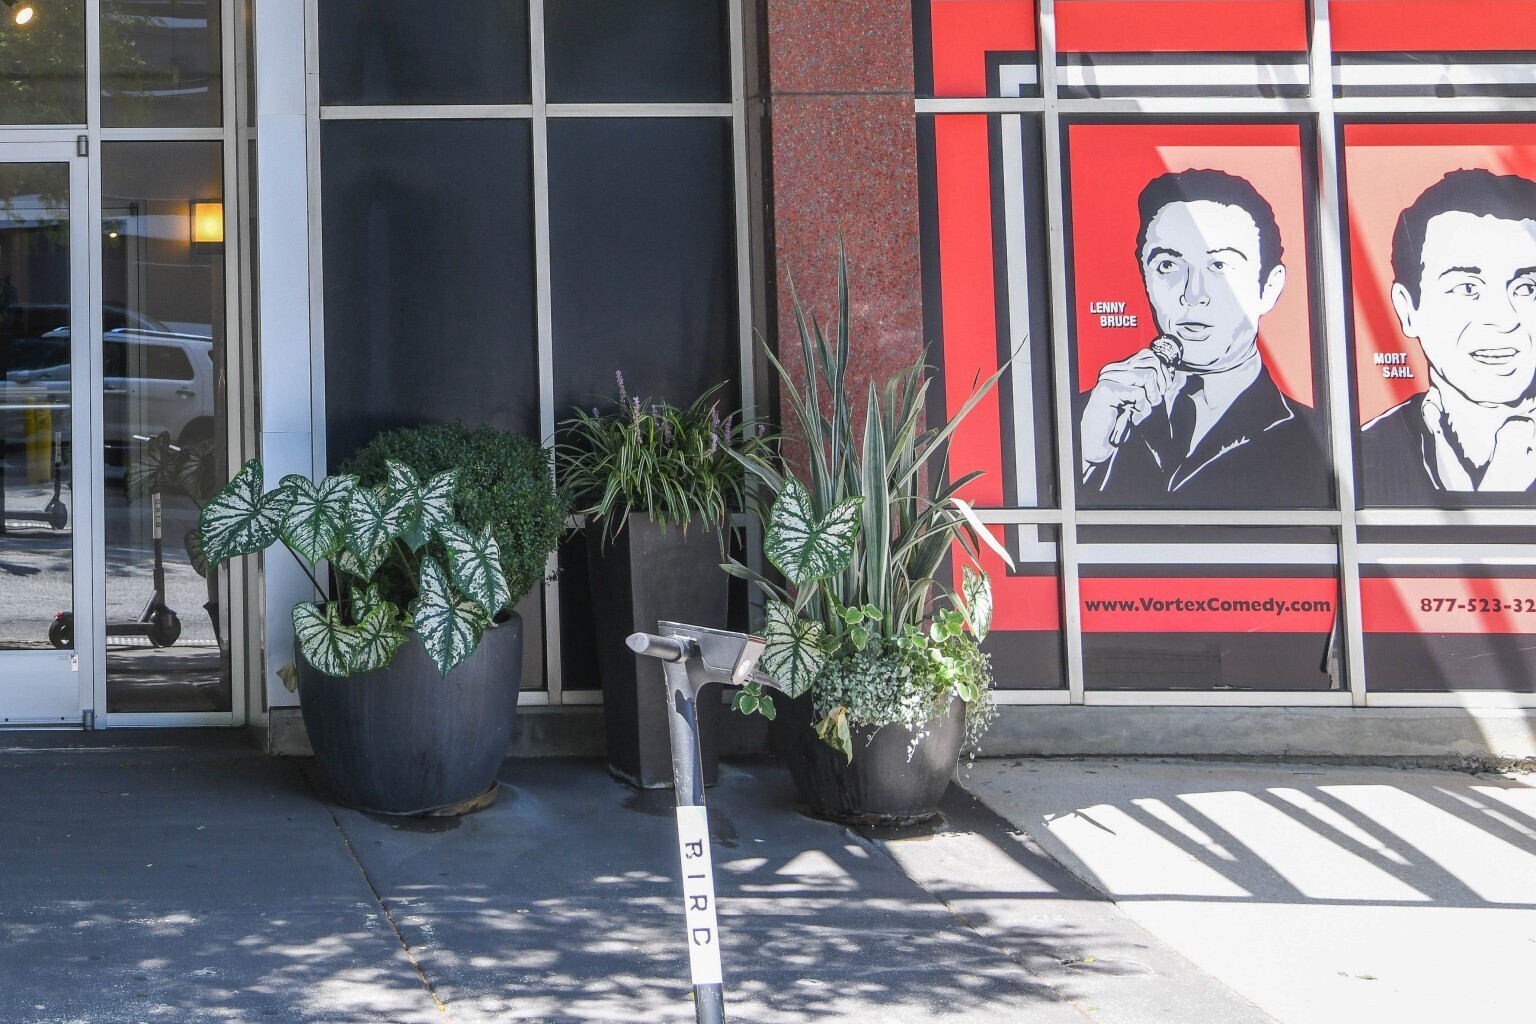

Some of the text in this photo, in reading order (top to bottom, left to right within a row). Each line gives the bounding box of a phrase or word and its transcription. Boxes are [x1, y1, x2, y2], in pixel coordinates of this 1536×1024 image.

[1090, 302, 1126, 315] LENNY
[1100, 315, 1138, 328] BRUCE
[1374, 353, 1407, 365] MORT
[1382, 366, 1414, 379] SAHL
[1084, 596, 1332, 616] www.VortexComedy.com
[1420, 598, 1536, 612] 877-523-32
